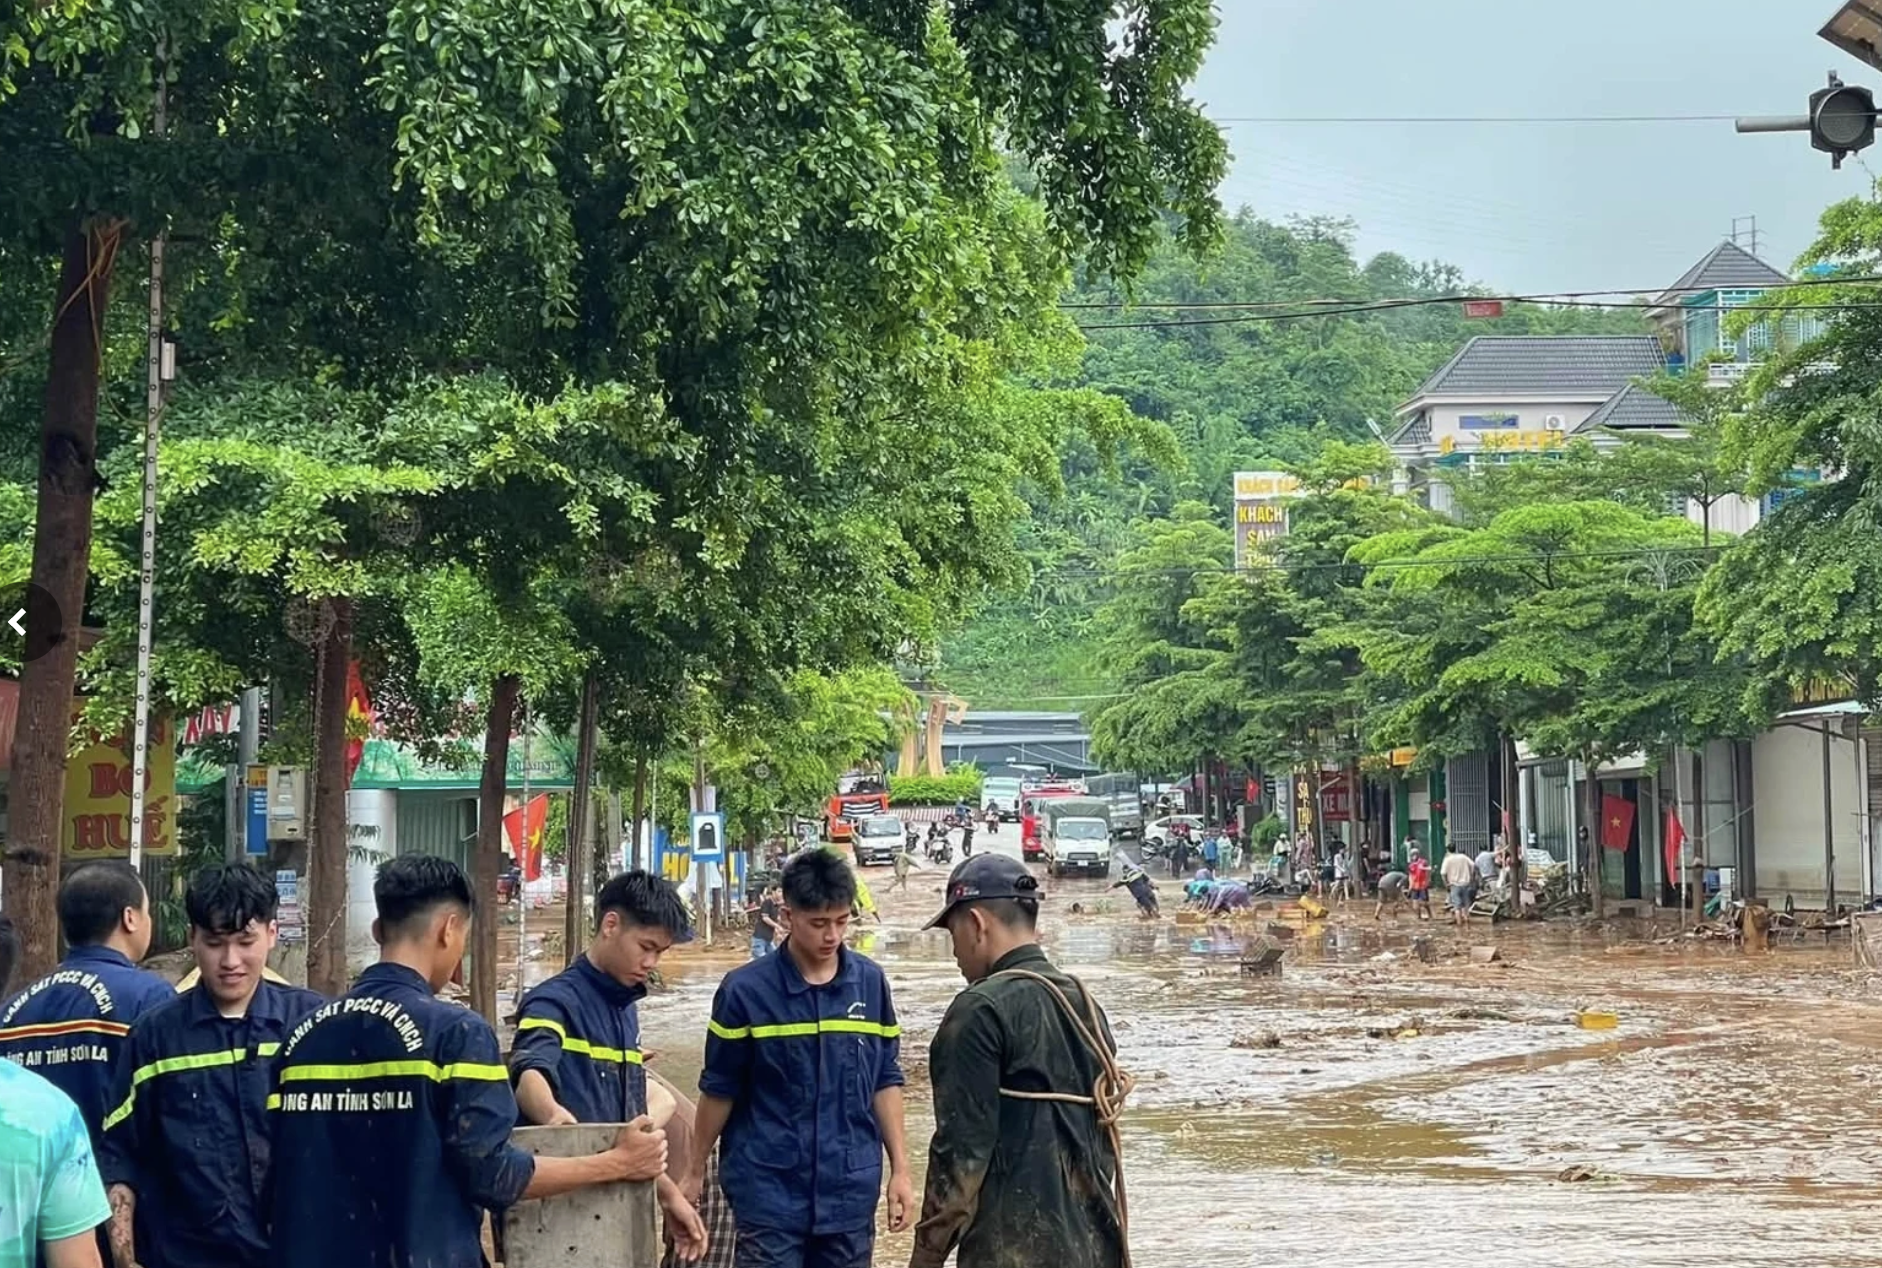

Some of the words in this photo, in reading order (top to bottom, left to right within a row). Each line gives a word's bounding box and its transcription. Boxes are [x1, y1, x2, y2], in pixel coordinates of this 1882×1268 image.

[51, 970, 83, 985] PCCC
[90, 982, 114, 1015] CNCH
[343, 996, 384, 1015] PCCC
[393, 1013, 425, 1053] CNCH
[91, 1045, 108, 1062] LA
[282, 1092, 307, 1112] NG
[310, 1092, 333, 1111] AN
[397, 1091, 413, 1110] LA
